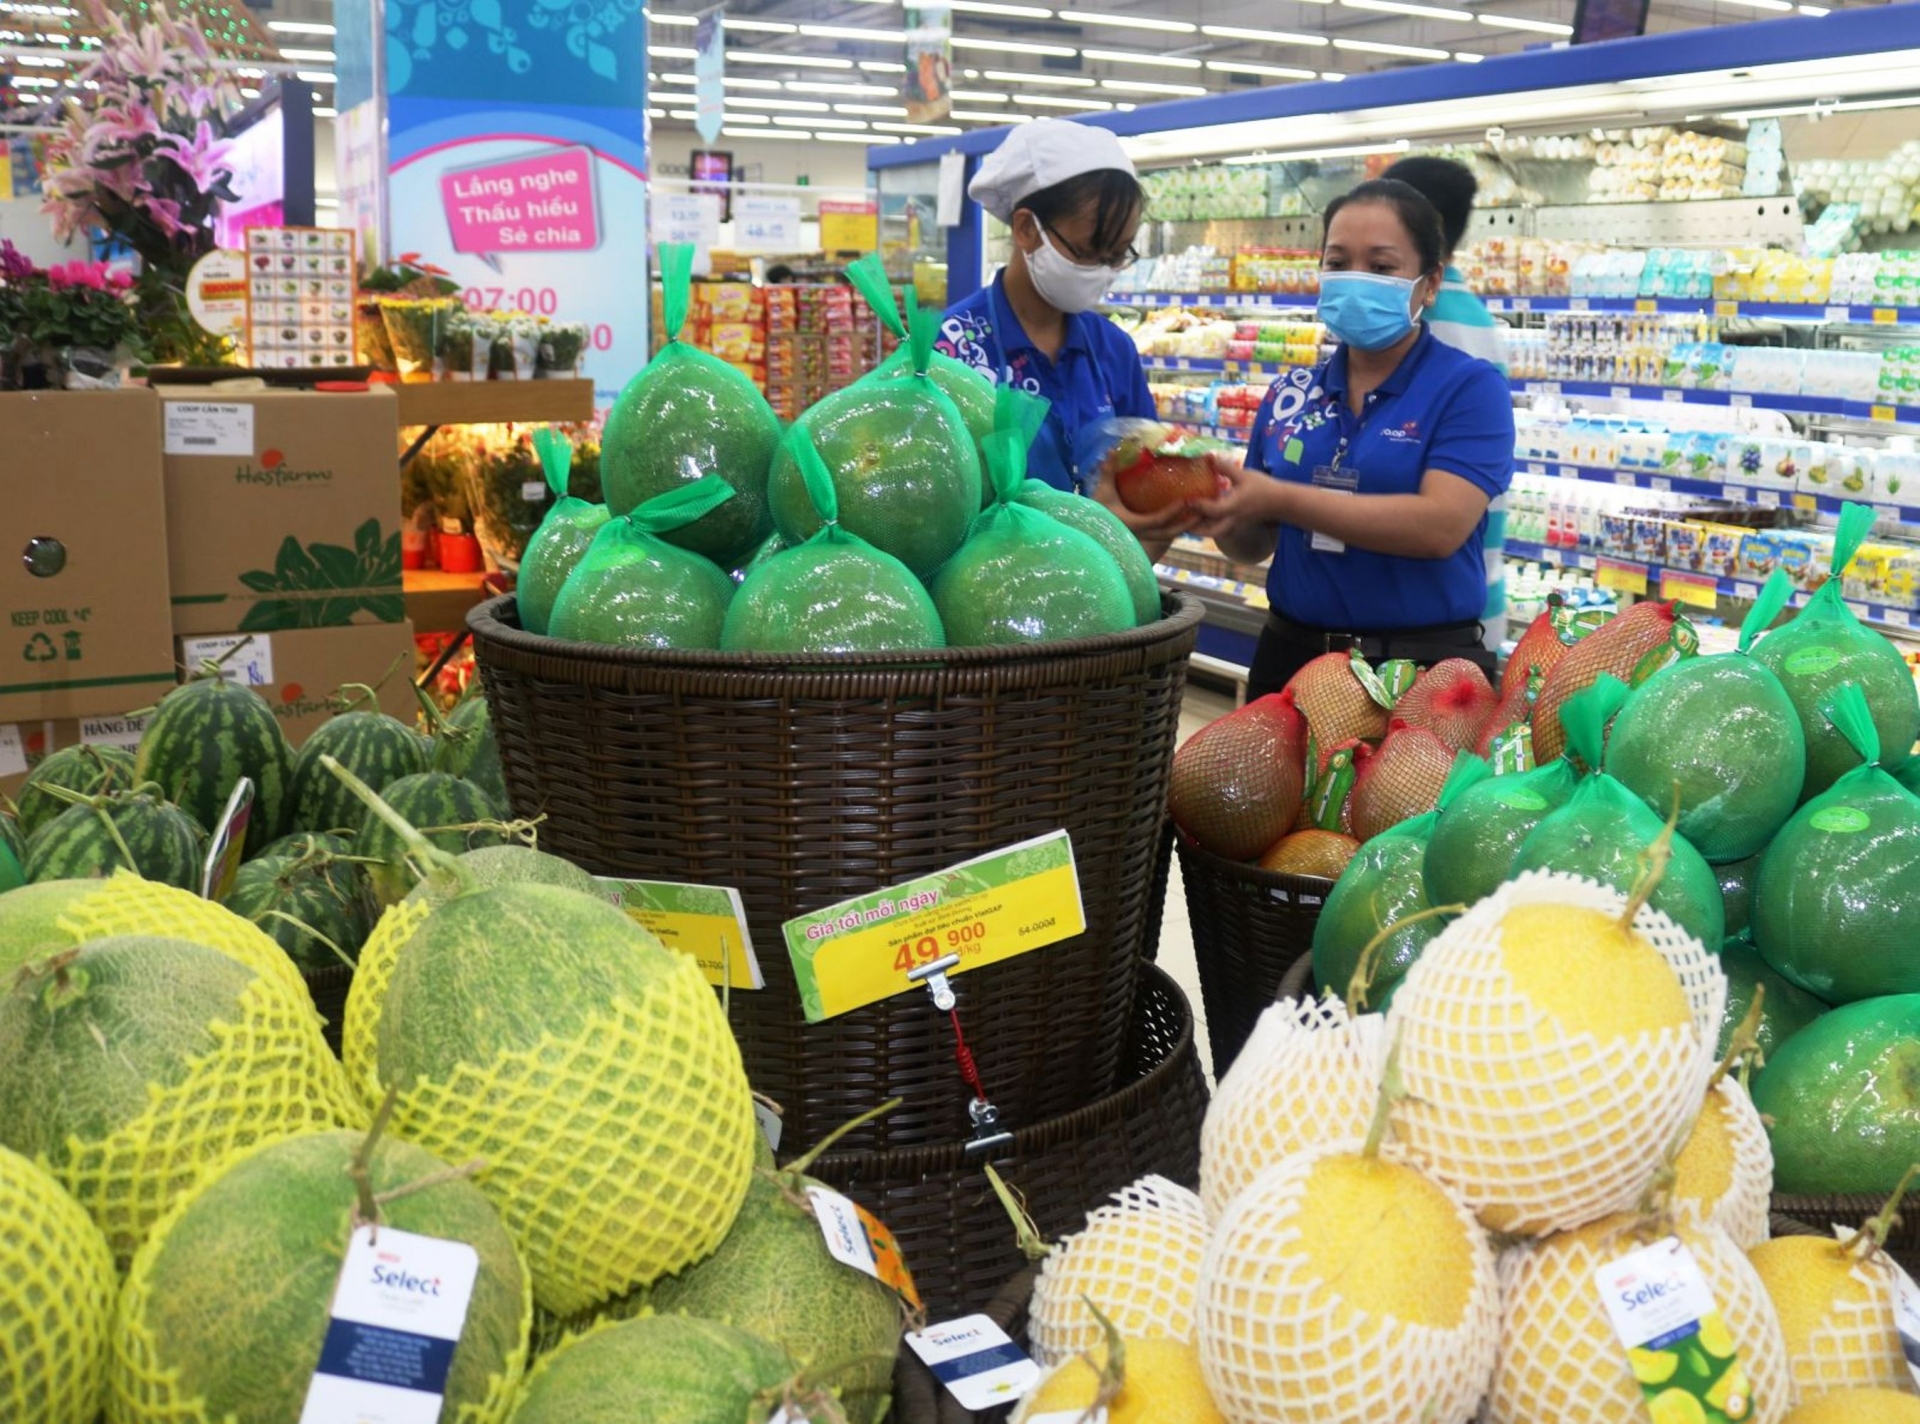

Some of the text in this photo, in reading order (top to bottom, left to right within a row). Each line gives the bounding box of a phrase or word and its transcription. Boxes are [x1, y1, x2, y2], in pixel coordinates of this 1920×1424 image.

[519, 168, 579, 192] nghe
[533, 226, 582, 243] chia
[464, 287, 558, 315] 07:00
[11, 610, 39, 627] KEEP
[43, 608, 70, 625] COOL
[84, 719, 122, 736] HÀNG
[806, 890, 938, 940] Giá tốt mỗi ngày
[893, 921, 986, 971] 49 900
[829, 1203, 857, 1256] Select
[371, 1263, 442, 1297] Select
[1620, 1272, 1687, 1312] Select
[932, 1327, 984, 1346] Select
